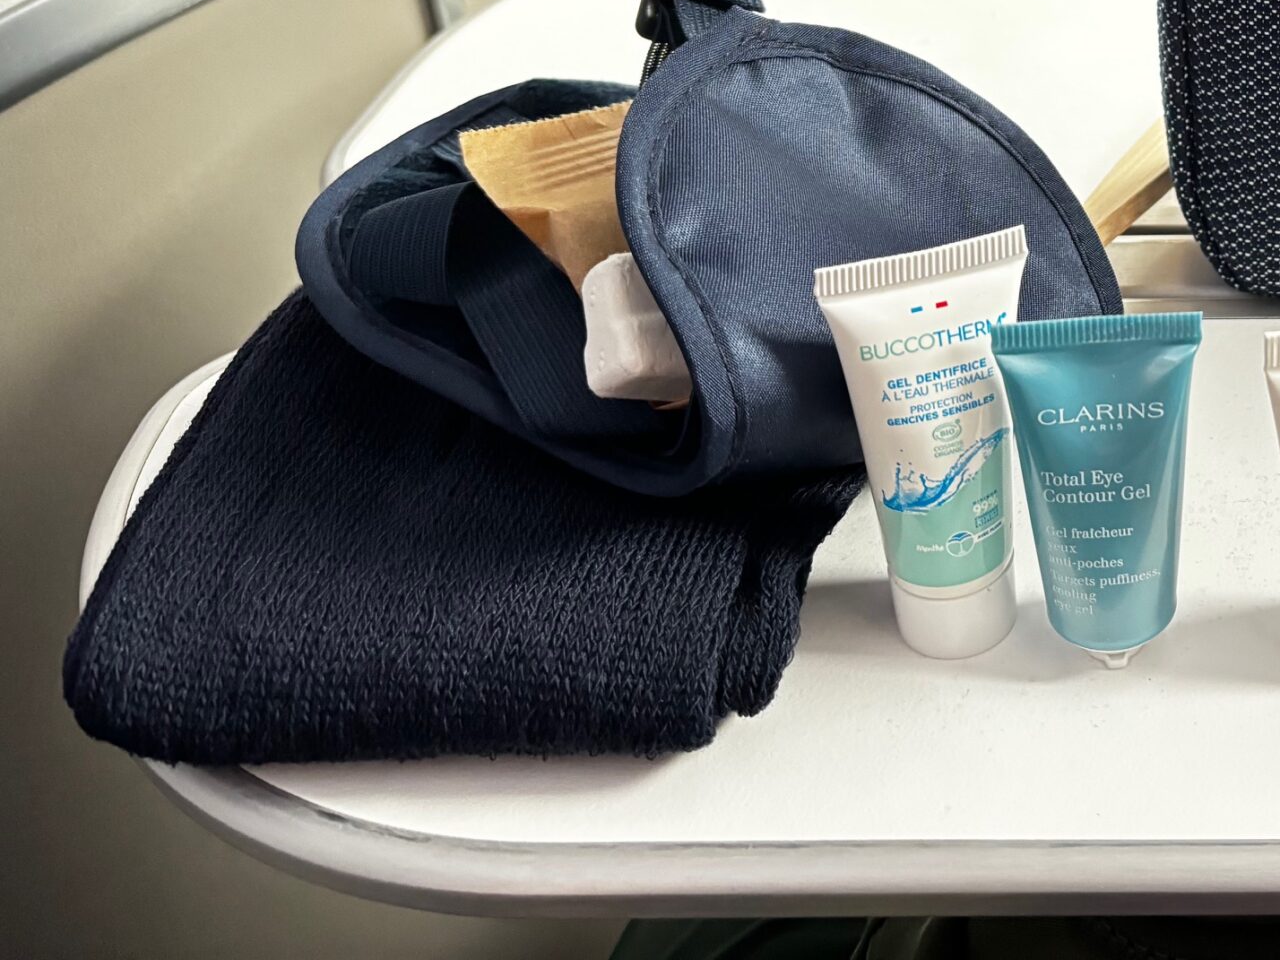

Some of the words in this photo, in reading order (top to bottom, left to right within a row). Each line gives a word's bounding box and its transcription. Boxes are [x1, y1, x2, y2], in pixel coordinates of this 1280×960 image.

[881, 390, 891, 403] À
[894, 385, 930, 402] L'EAU
[933, 367, 995, 394] THERMALE
[887, 377, 913, 390] GEL
[916, 357, 988, 386] DENTIFRICE
[886, 411, 940, 427] GENCIVES
[942, 393, 996, 418] SENSIBLES
[909, 391, 974, 415] PROTECTION
[1037, 401, 1165, 426] CLARINS
[1080, 423, 1124, 433] PARIS
[1040, 470, 1087, 487] Total
[1091, 470, 1124, 488] Eye
[1042, 488, 1116, 504] Contour
[1121, 484, 1151, 501] Gel
